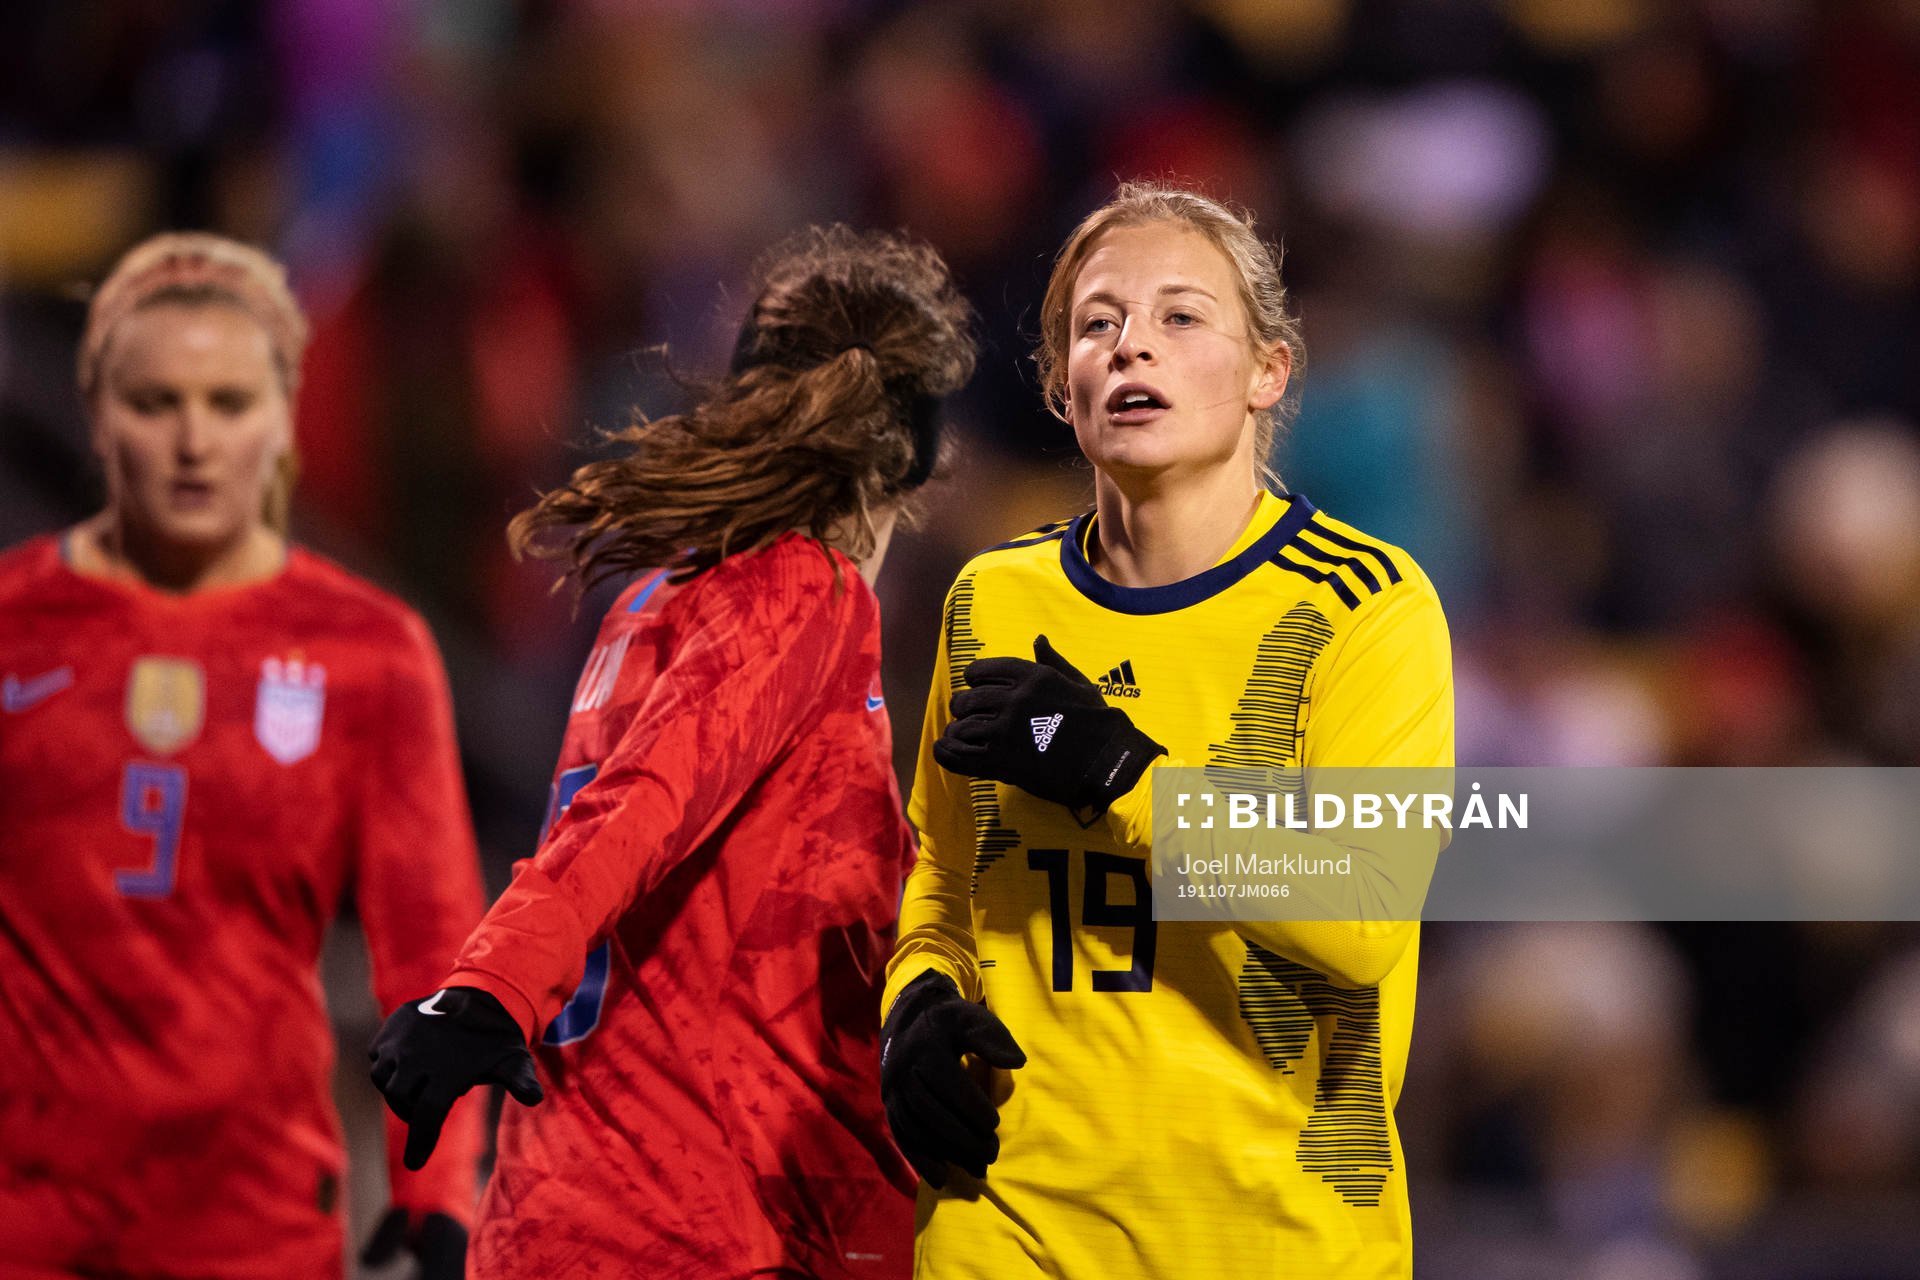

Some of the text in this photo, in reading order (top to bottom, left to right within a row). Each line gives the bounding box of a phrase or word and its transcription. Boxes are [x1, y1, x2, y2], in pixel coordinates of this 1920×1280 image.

[1038, 712, 1064, 752] adidas
[1096, 681, 1141, 698] didas
[113, 760, 188, 900] 9
[1028, 848, 1157, 993] 19
